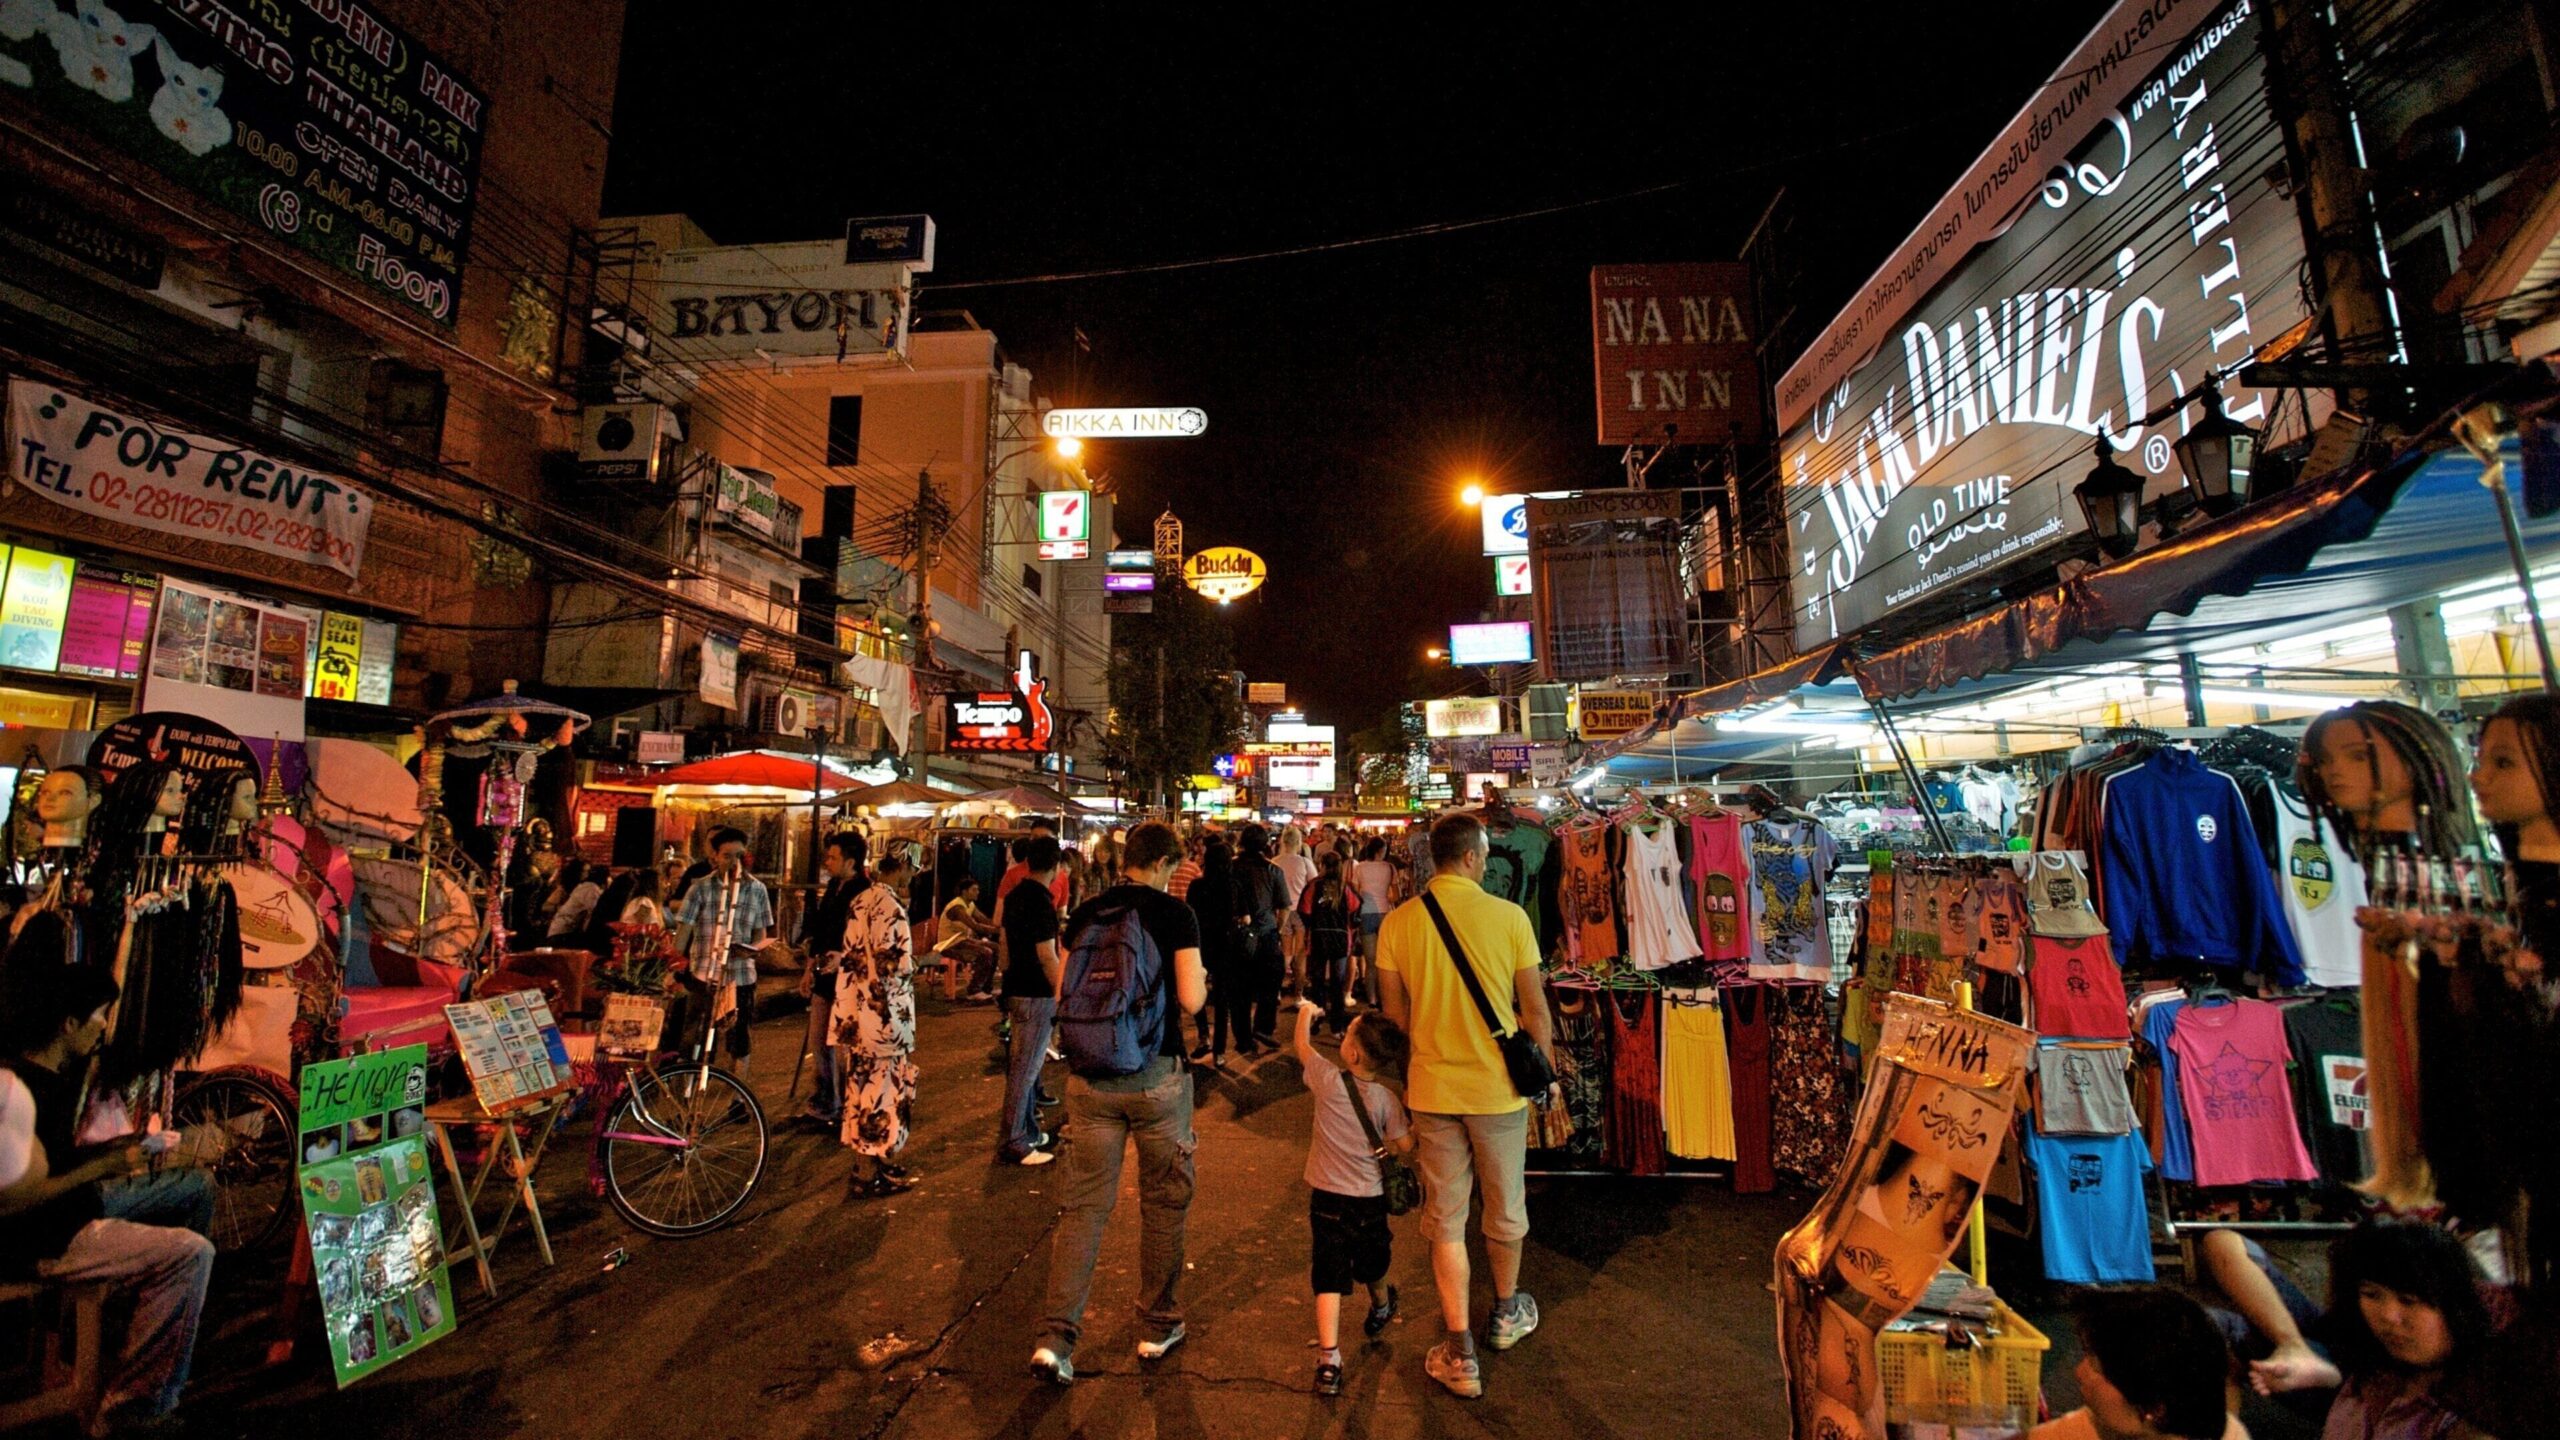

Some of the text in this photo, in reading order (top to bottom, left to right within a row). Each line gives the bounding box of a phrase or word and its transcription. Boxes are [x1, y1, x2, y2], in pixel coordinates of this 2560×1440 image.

[420, 60, 481, 132] PARK
[235, 120, 299, 177] 10.00
[306, 67, 469, 203] THAILAND
[295, 120, 462, 239] OPEN DAILY
[354, 232, 450, 320] Floor)
[670, 290, 878, 338] BAYON
[1625, 369, 1734, 412] INN
[75, 411, 191, 478] FOR
[1048, 413, 1175, 432] RIKKA INN
[21, 438, 82, 498] TEL.
[203, 450, 342, 515] RENT
[597, 462, 638, 476] PEPSI
[1820, 383, 1916, 592] JACK
[1051, 497, 1079, 537] 7
[1542, 496, 1671, 517] COMING SOON
[1908, 475, 2012, 551] OLD TIME
[1196, 553, 1252, 578] Buddy
[1920, 575, 1932, 593] Jack
[1957, 556, 1980, 575] remind
[1979, 553, 1992, 568] you
[2000, 536, 2020, 555] drink
[12, 613, 54, 628] DIVING
[326, 629, 357, 646] SEAS
[327, 617, 358, 632] OVER
[953, 702, 1023, 728] Tempo
[1581, 695, 1650, 711] OVERSEAS CALL
[1602, 712, 1651, 728] INTERNET
[1492, 748, 1526, 761] MOBILE
[314, 1061, 409, 1110] HENNA
